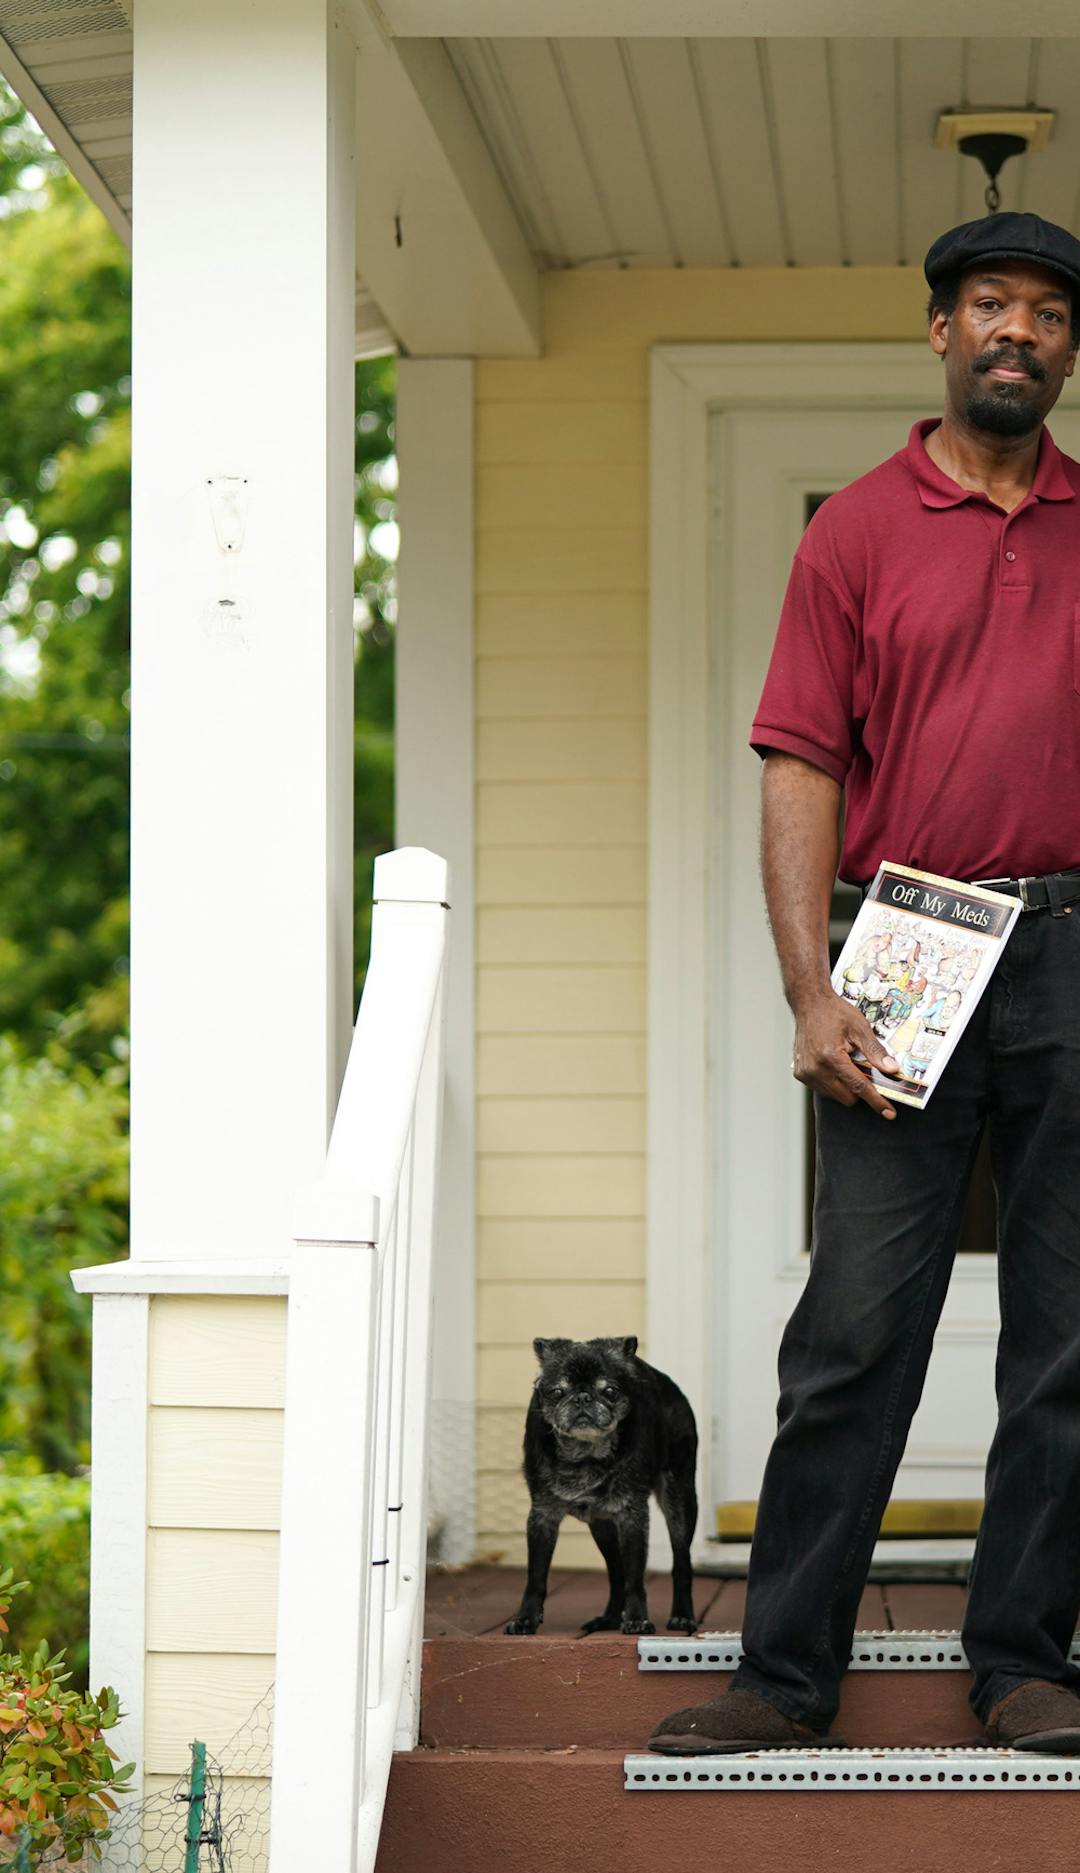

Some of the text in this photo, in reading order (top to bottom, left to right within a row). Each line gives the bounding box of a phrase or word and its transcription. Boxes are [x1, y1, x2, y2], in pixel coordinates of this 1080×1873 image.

[892, 885, 990, 927] Off My Meds
